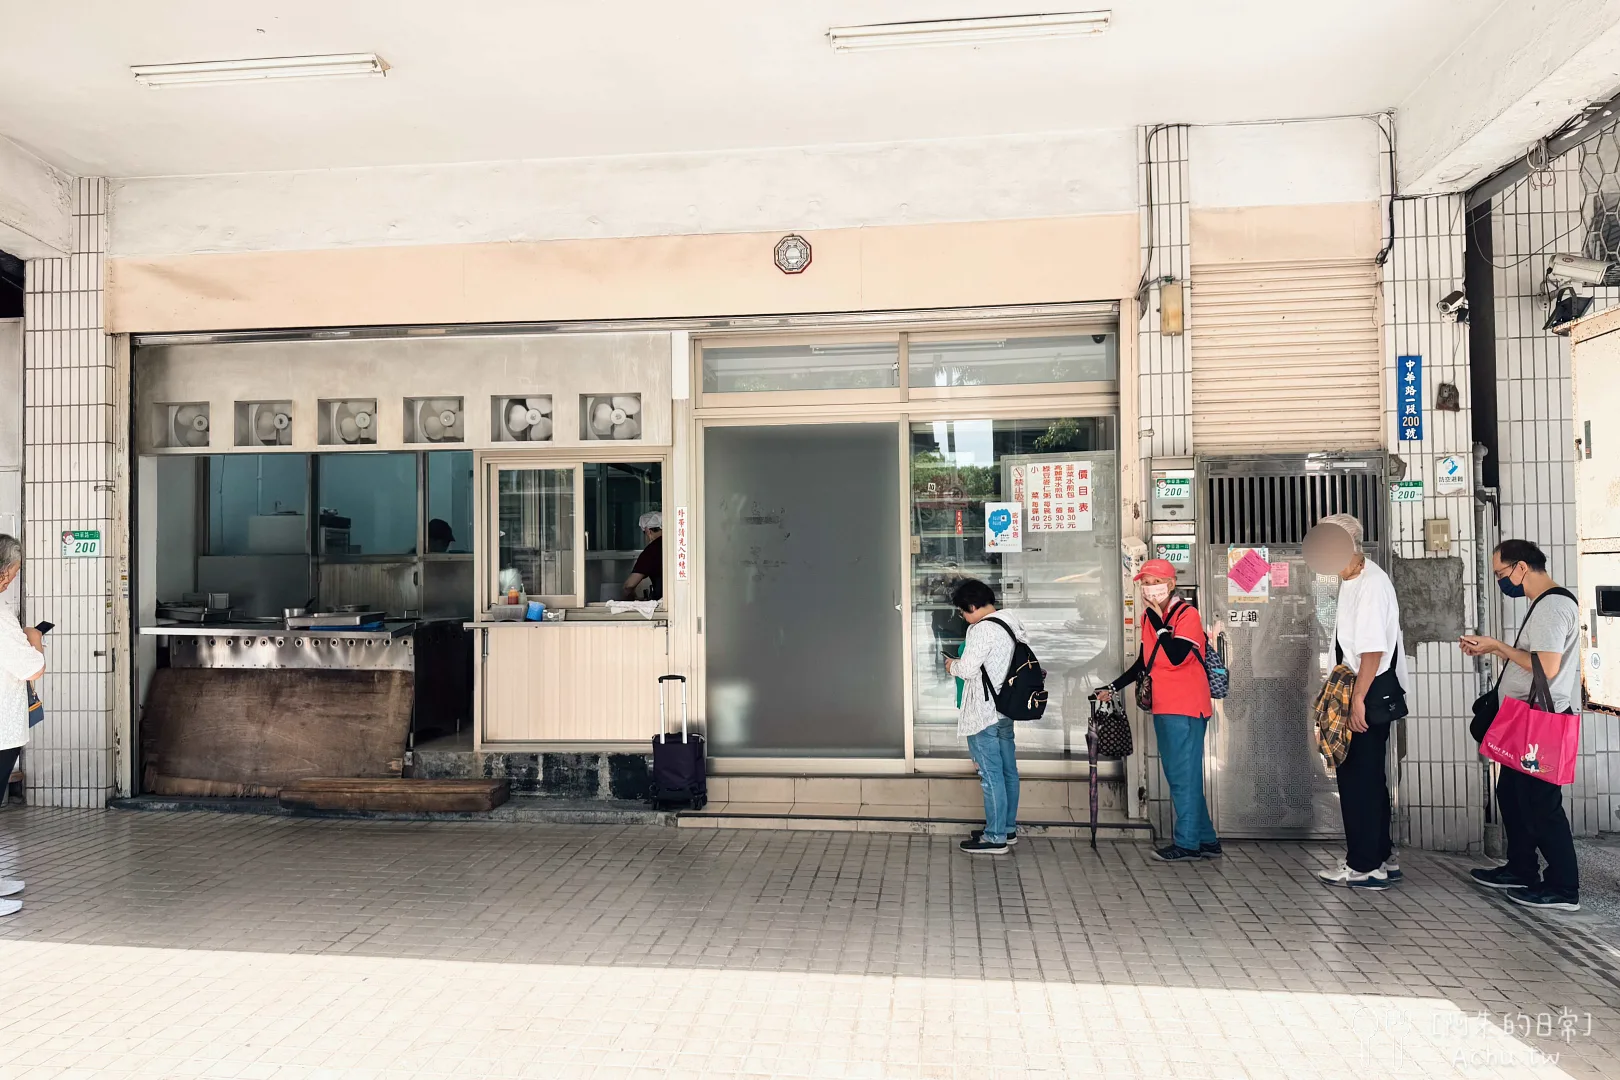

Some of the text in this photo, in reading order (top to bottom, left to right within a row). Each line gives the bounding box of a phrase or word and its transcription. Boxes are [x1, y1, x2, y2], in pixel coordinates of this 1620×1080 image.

[1078, 470, 1088, 512] 價目表
[1164, 488, 1182, 496] 200
[1398, 490, 1416, 499] 200
[75, 542, 96, 553] 200
[1164, 552, 1182, 561] 200
